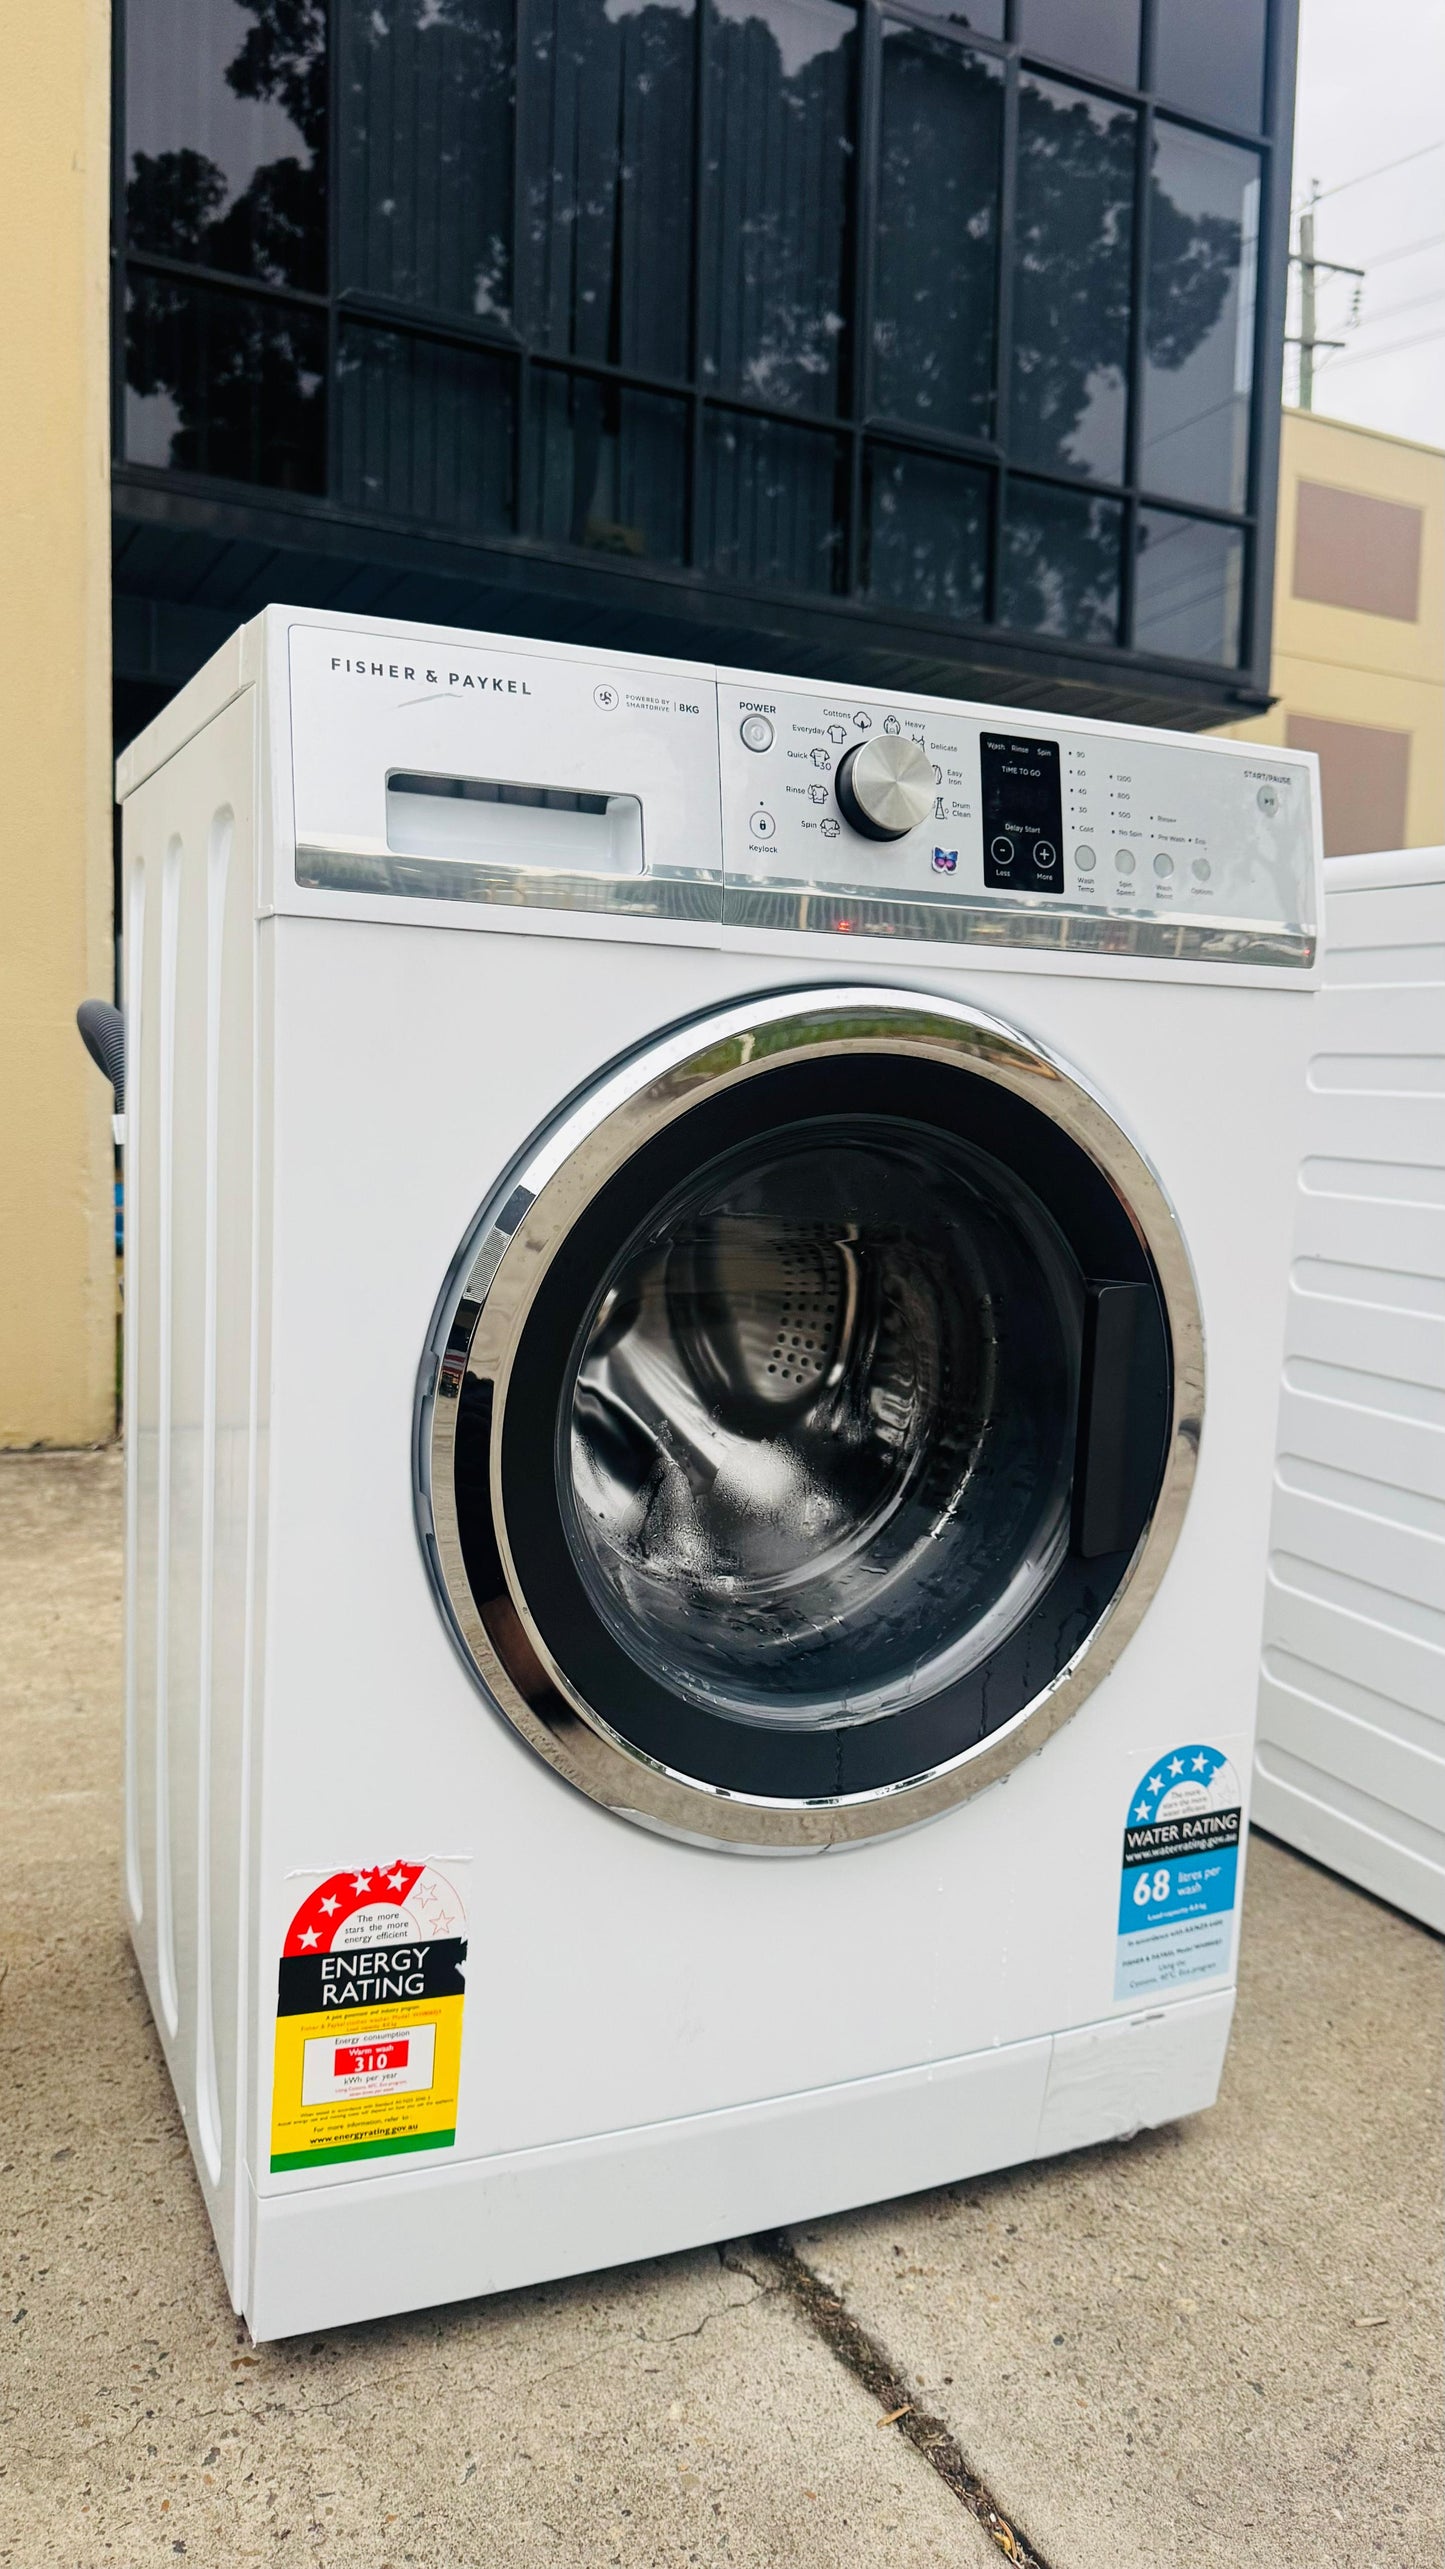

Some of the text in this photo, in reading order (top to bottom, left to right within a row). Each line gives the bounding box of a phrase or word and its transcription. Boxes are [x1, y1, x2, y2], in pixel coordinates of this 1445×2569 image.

[331, 657, 532, 695] FISHER & PAYKEL
[626, 694, 659, 704] POWERED
[626, 702, 670, 712] SMARTDRIVE
[679, 703, 700, 714] 8KG
[739, 701, 777, 714] POWER
[823, 709, 851, 719] Cottons
[792, 724, 826, 736] Everyday
[905, 720, 926, 730] Heavy
[930, 742, 958, 753] Delicate
[987, 741, 1052, 757] Wash Rinse Spin
[787, 750, 808, 760] Quick
[820, 762, 832, 771] 30
[1001, 765, 1041, 777] TIME TO GO
[947, 769, 963, 778] Easy
[1116, 775, 1132, 783] 1200
[948, 778, 962, 786] Iron
[786, 786, 806, 795] Rinse
[952, 801, 971, 809] Drum
[952, 810, 971, 818] Clean
[801, 821, 817, 830] Spin
[1005, 823, 1041, 834] Delay Start
[749, 844, 778, 855] Keylock
[996, 869, 1011, 878] Less
[1036, 873, 1053, 881] More
[1127, 1813, 1238, 1848] WATER RATING
[1133, 1869, 1171, 1906] 68
[357, 1912, 400, 1923] The more
[345, 1921, 409, 1934] stars the more
[344, 1930, 408, 1943] energy efficient
[321, 1947, 430, 1980] ENERGY
[322, 1973, 425, 2006] RATING
[335, 2030, 410, 2045] Energy consumption
[349, 2044, 394, 2056] Warm wash
[354, 2053, 388, 2072] 310
[344, 2076, 362, 2085] kWh
[366, 2074, 378, 2083] per
[382, 2072, 398, 2081] year
[384, 2115, 398, 2123] refer
[310, 2124, 418, 2144] www.energyrating.gov.au
